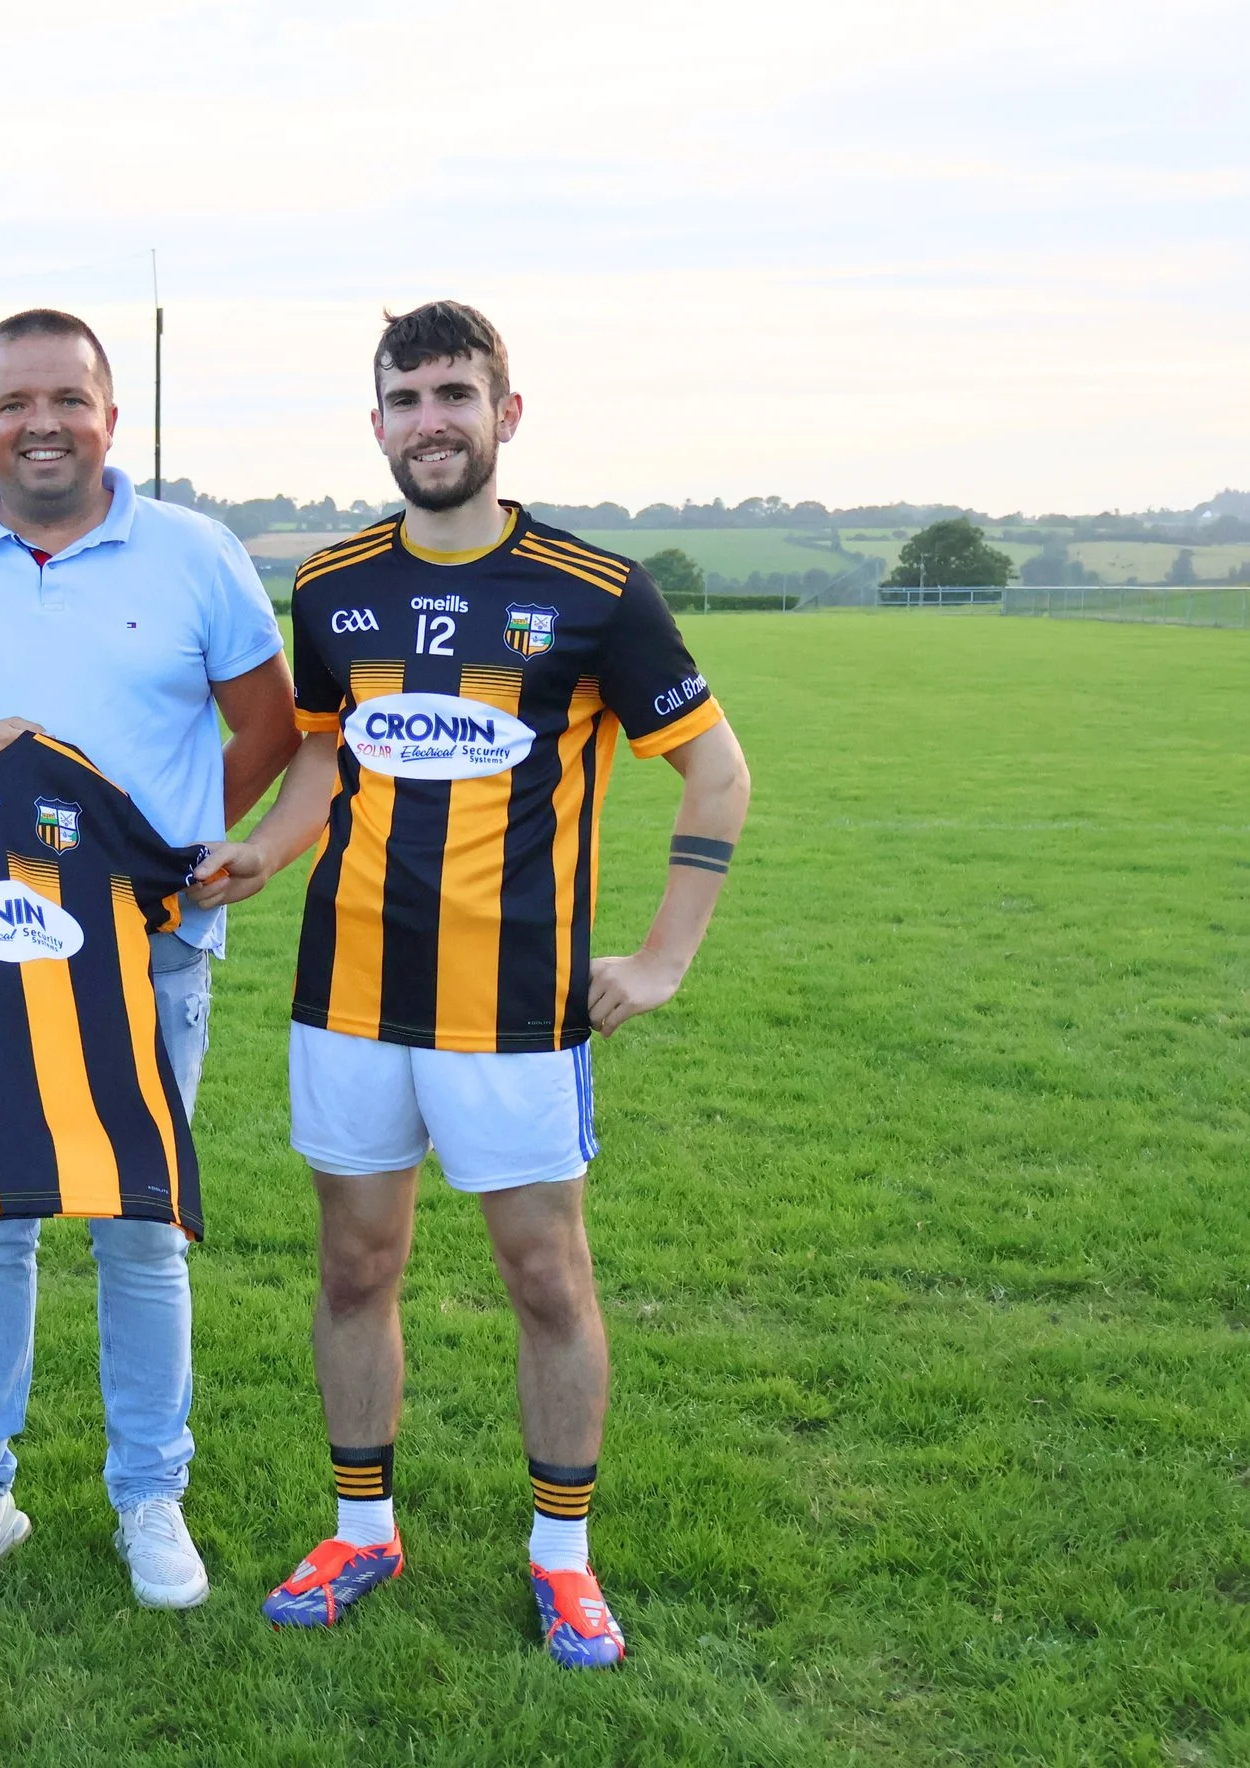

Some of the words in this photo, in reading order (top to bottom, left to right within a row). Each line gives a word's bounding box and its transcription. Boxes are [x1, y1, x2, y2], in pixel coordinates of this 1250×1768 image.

[415, 614, 456, 656] 12
[365, 712, 496, 745] CRONIN
[356, 743, 392, 759] SOLAR
[400, 745, 458, 760] Electrical
[462, 745, 511, 760] Security
[469, 755, 503, 765] Systems
[22, 927, 63, 949] Security
[31, 937, 59, 952] Systems
